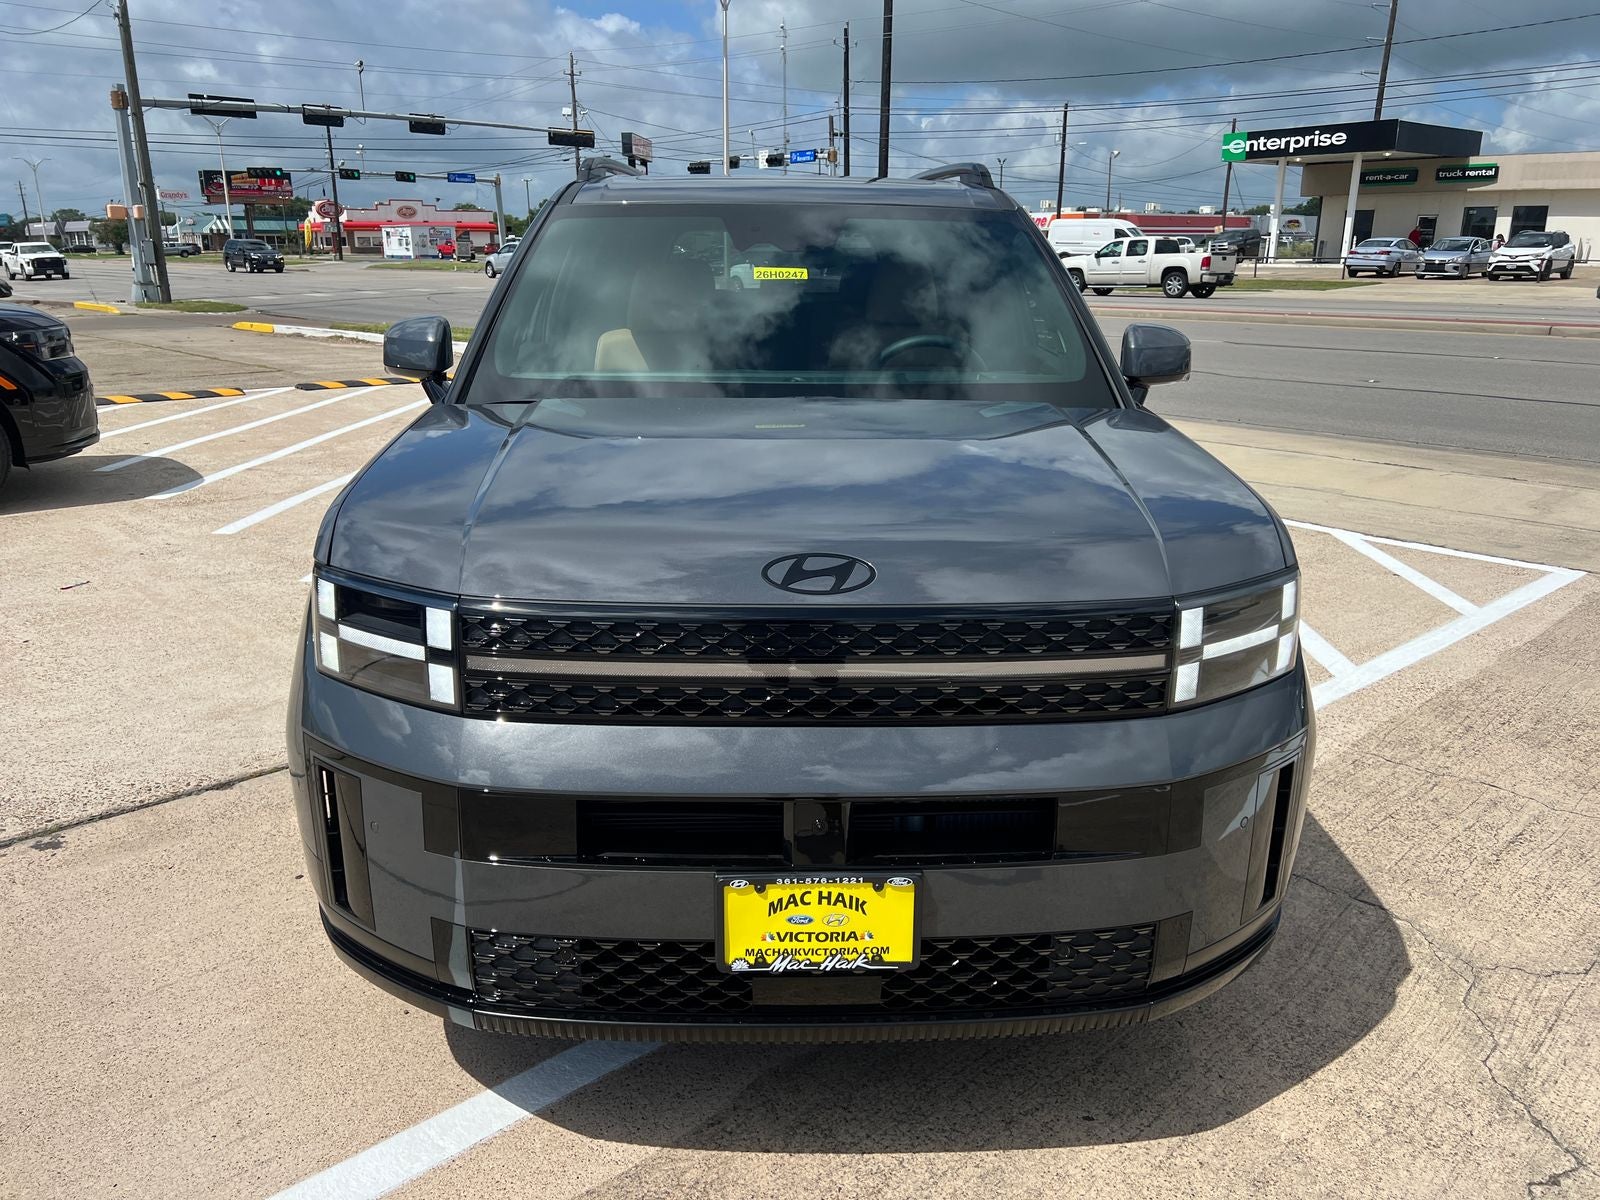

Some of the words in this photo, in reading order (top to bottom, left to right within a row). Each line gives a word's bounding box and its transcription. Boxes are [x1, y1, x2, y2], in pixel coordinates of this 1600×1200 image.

[1222, 130, 1348, 153] enterprise
[1365, 173, 1409, 181] rent-a-car
[1438, 169, 1463, 178] truck
[1465, 168, 1496, 177] rental
[160, 191, 188, 199] Grandy's
[1031, 215, 1048, 228] ne
[755, 270, 805, 279] 26H0247
[776, 877, 864, 885] 361-576-1221
[889, 878, 911, 886] Ford
[768, 890, 812, 917] MAC
[817, 890, 868, 916] HAIK
[790, 915, 811, 925] Ford
[776, 931, 859, 943] VICTORIA
[745, 946, 890, 957] MACHAIKVICTORIA.COM
[769, 954, 818, 973] Mac
[819, 954, 871, 972] Haik
